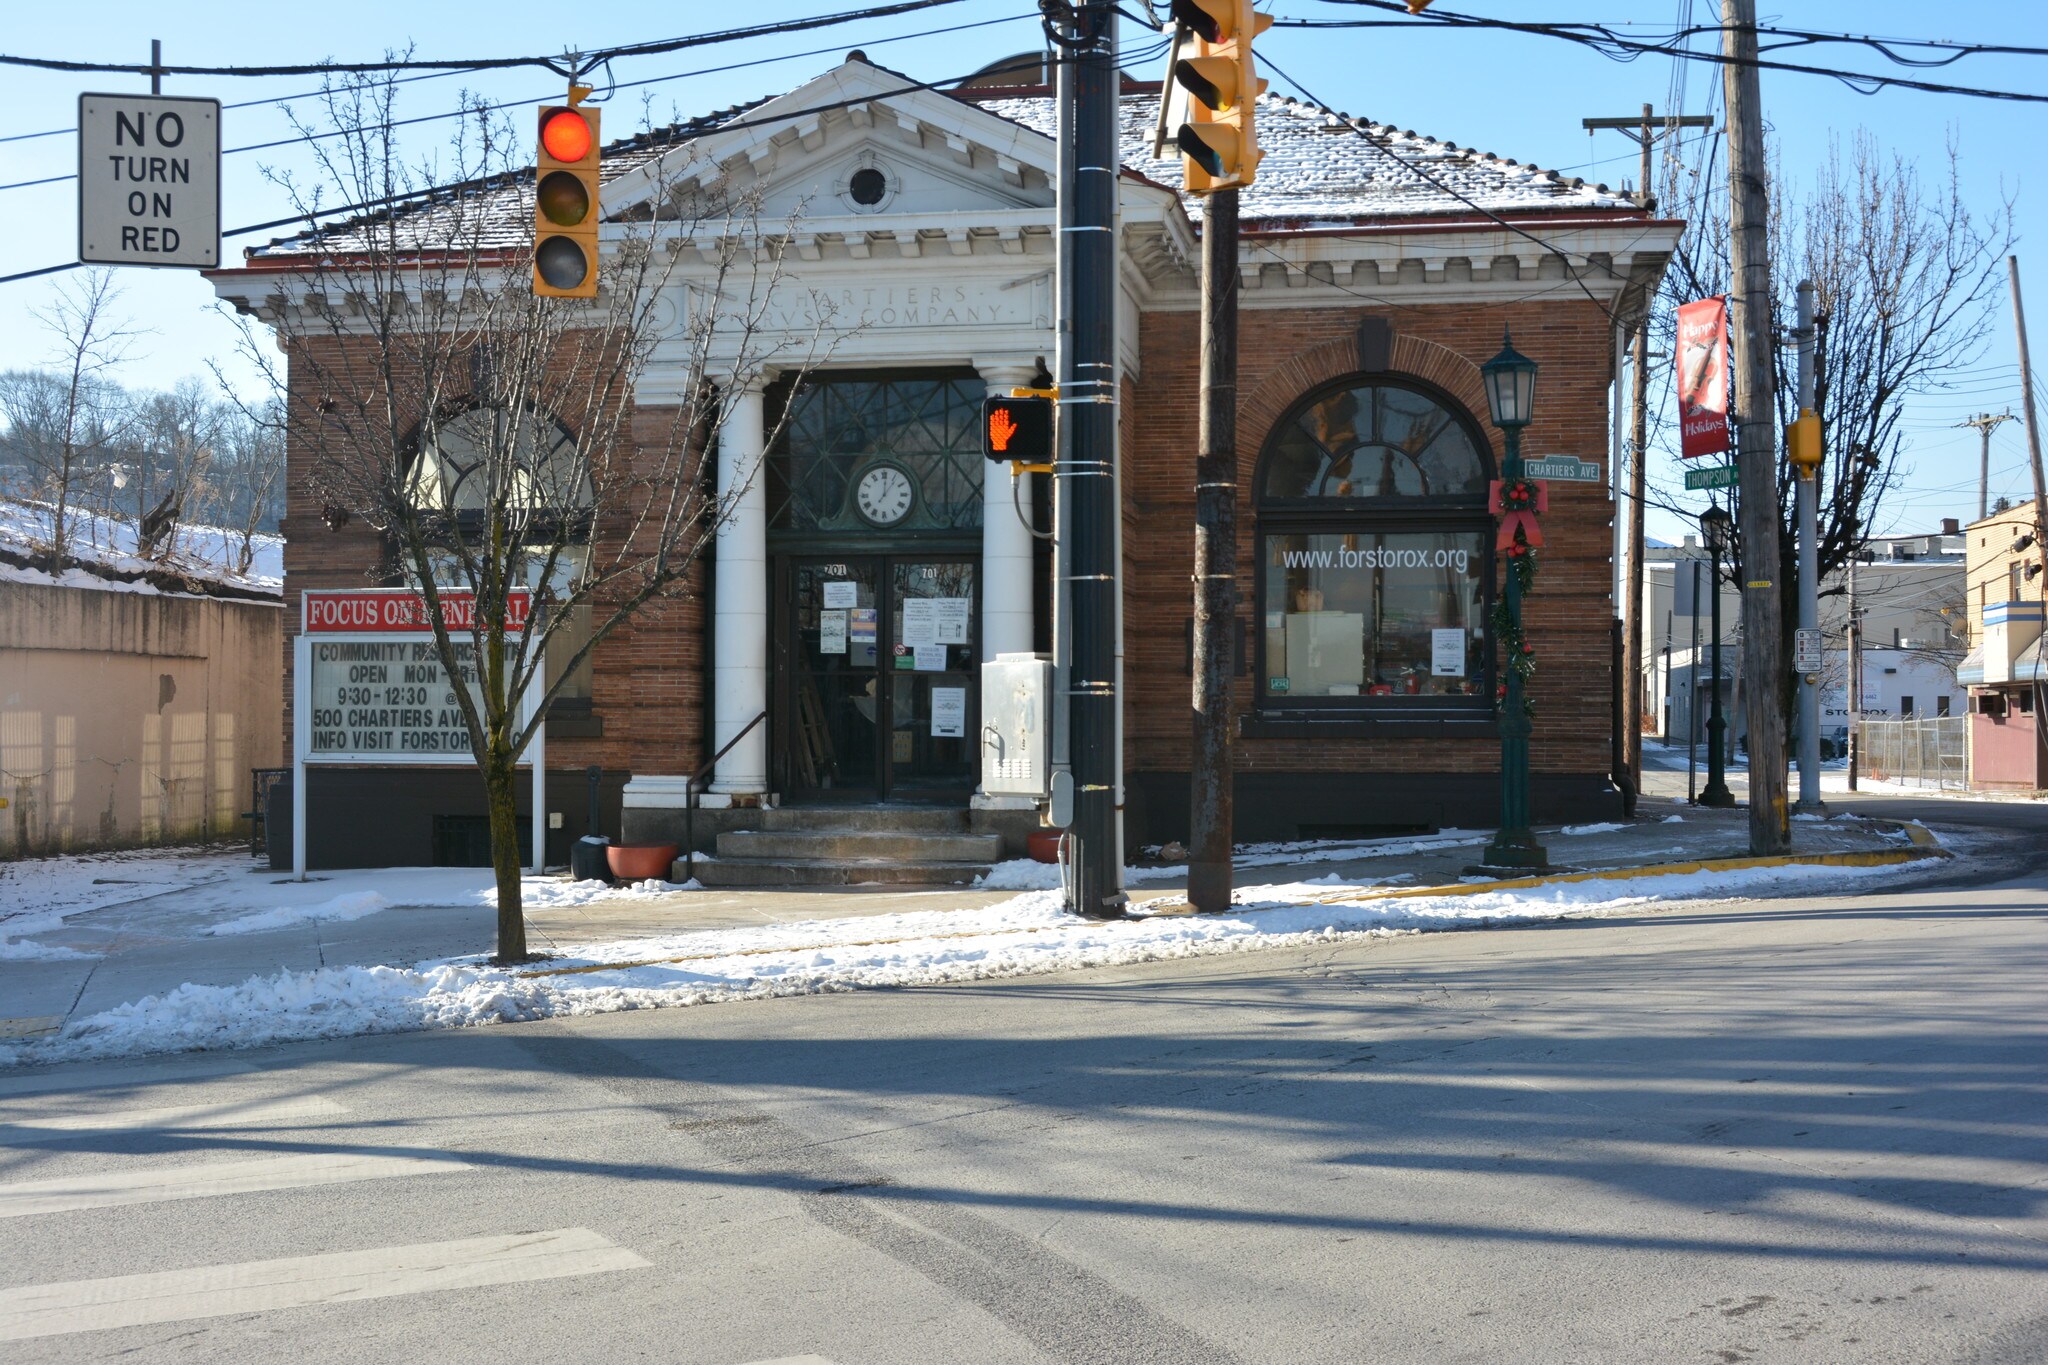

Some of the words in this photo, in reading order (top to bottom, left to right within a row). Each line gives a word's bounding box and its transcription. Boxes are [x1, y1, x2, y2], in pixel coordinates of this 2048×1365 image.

[116, 111, 184, 148] NO
[109, 156, 189, 183] TURN
[128, 191, 171, 218] ON
[122, 226, 180, 252] RED
[771, 286, 966, 308] CHARTIERS
[861, 304, 1001, 324] COMPANY
[1683, 320, 1718, 338] Happy
[1685, 419, 1724, 437] Holidays
[1529, 463, 1575, 477] CHARTIERS
[1687, 469, 1731, 487] THOMPSON
[1283, 545, 1468, 574] www.forstorox.org
[922, 568, 937, 578] 701
[309, 600, 378, 625] FOCUS
[384, 600, 414, 625] ON
[320, 644, 407, 661] COMMUNITY
[350, 665, 387, 683] OPEN
[313, 709, 343, 728] 500
[349, 709, 433, 728] CHARTIERS
[313, 731, 347, 749] INFO
[353, 731, 393, 749] VISIT
